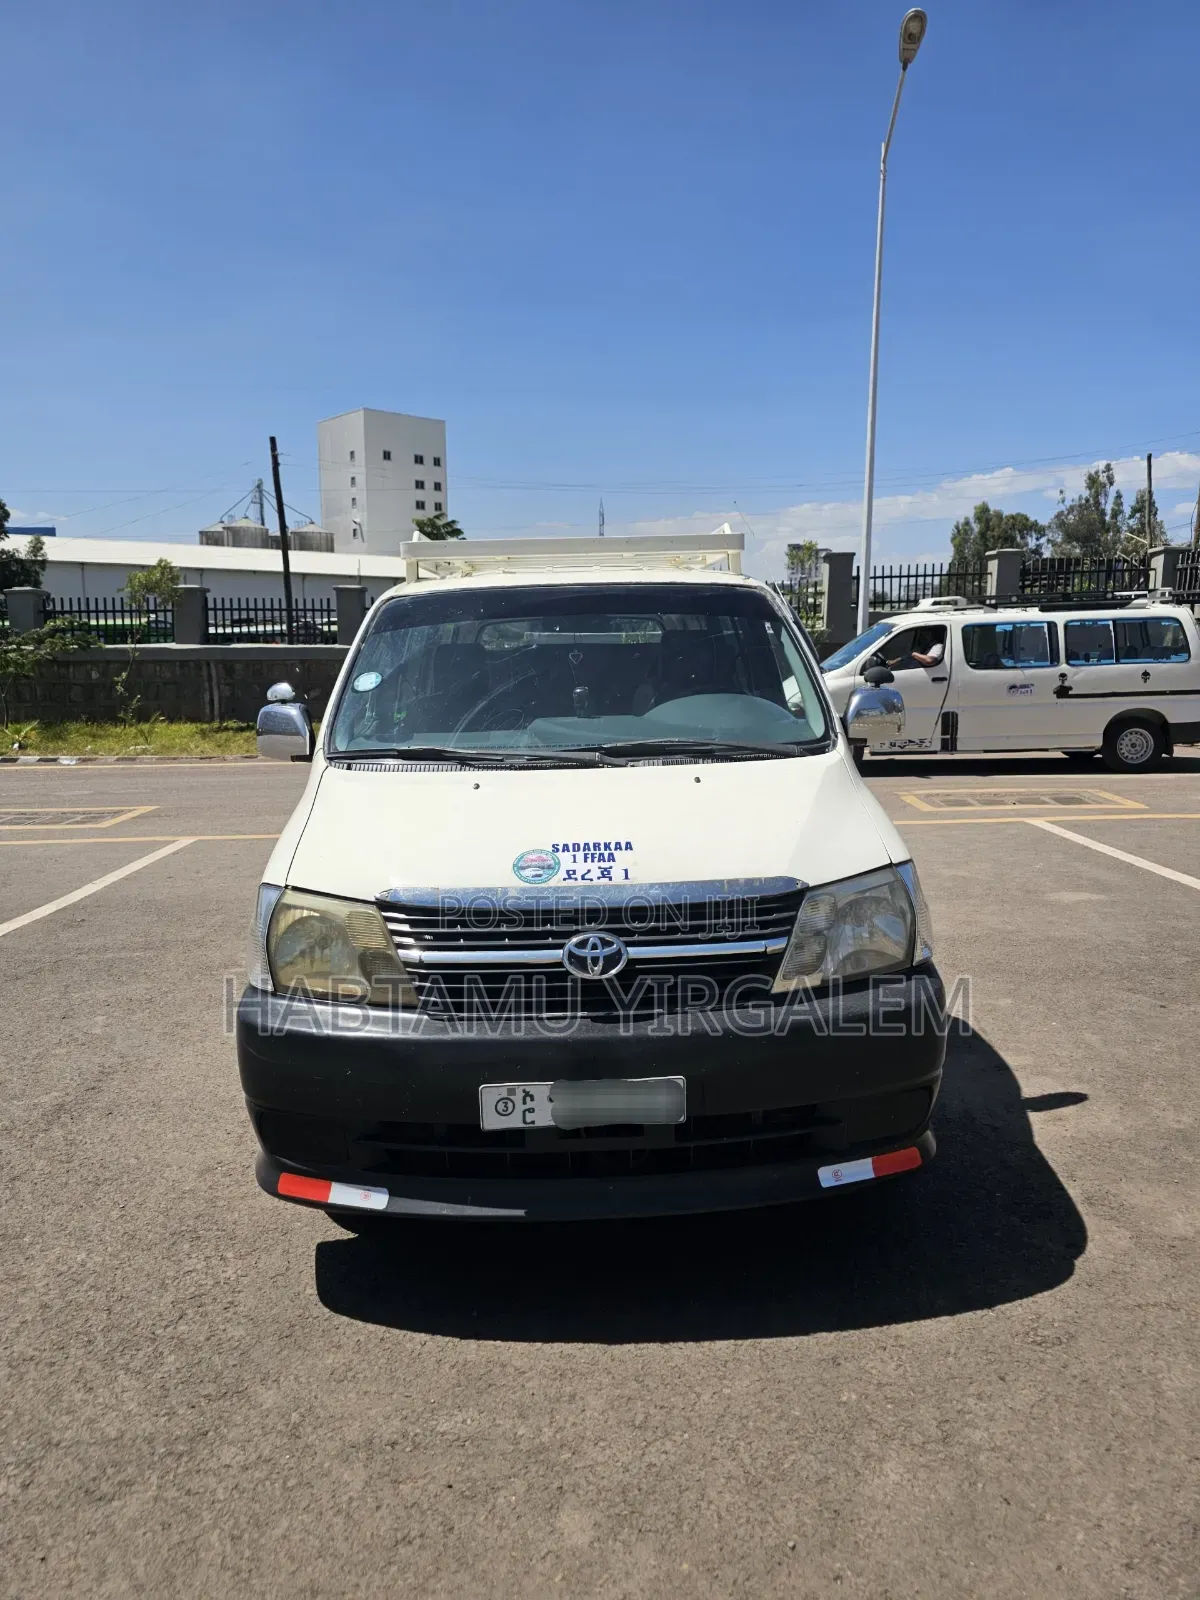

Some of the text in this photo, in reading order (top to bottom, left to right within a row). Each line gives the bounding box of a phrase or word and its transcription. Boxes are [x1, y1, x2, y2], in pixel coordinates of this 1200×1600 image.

[551, 842, 633, 853] SADARKAA
[583, 852, 616, 863] FFAA
[621, 868, 630, 880] 1
